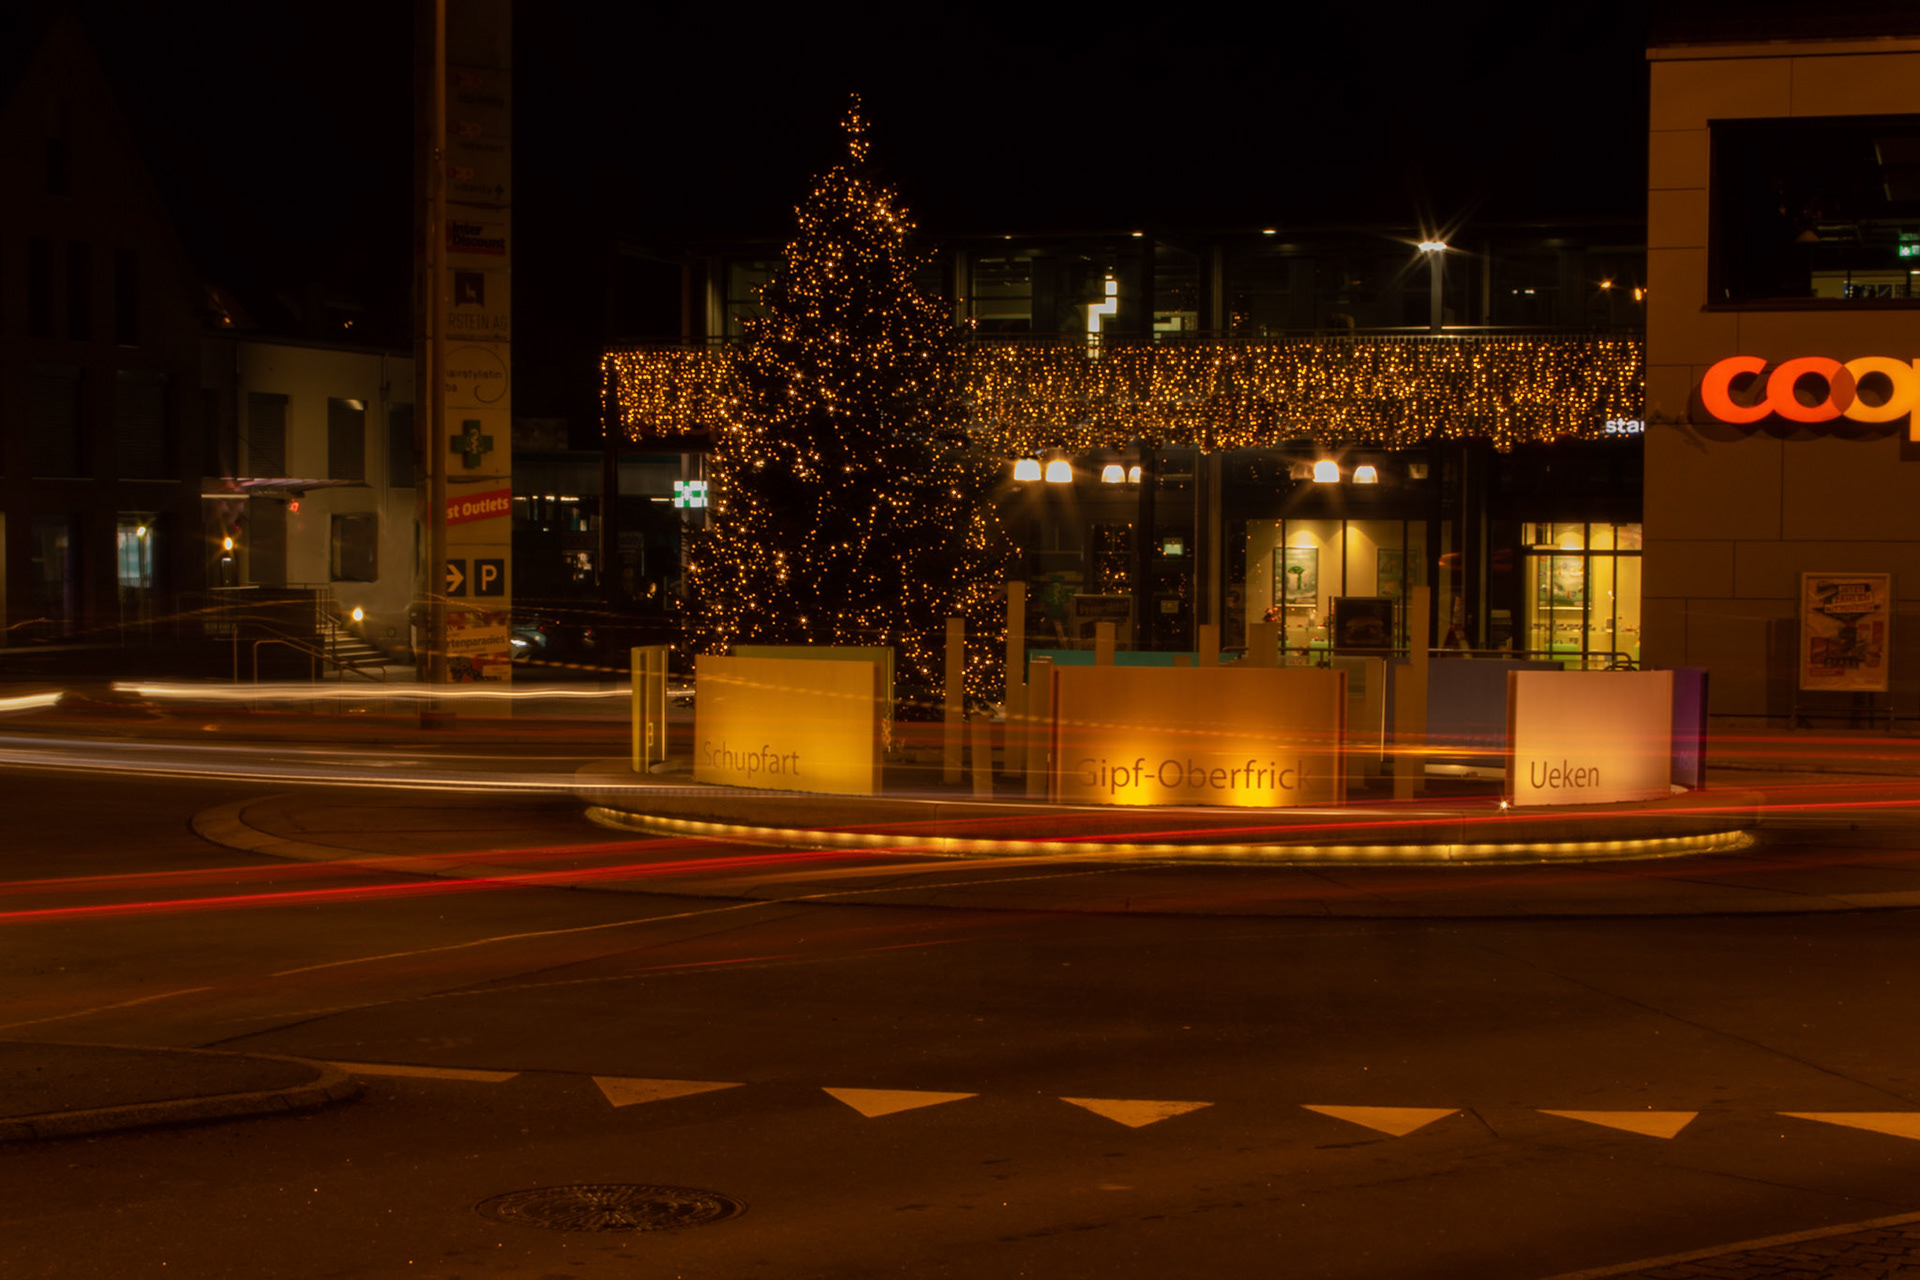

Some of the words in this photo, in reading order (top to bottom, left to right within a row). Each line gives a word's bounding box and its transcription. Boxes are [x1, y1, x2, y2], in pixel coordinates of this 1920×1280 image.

[452, 234, 506, 249] Discount
[453, 221, 482, 235] Inter
[447, 312, 489, 330] RSTEIN
[491, 315, 509, 332] AG
[1701, 355, 1920, 442] coo
[447, 504, 460, 520] st
[461, 496, 510, 516] Outlets
[480, 564, 497, 591] P
[703, 738, 800, 778] Schupfart
[1076, 756, 1314, 795] Gipf-Oberfrick
[1530, 759, 1600, 790] Ueken
